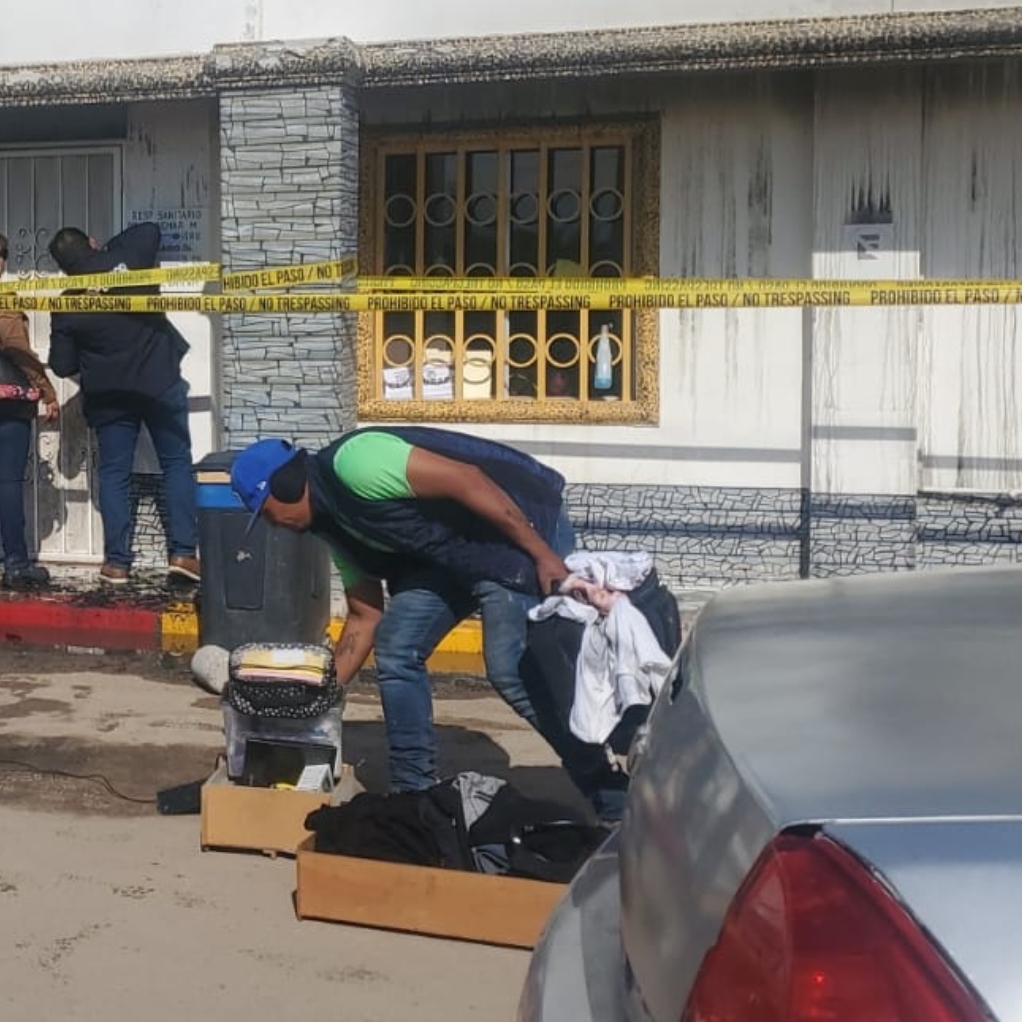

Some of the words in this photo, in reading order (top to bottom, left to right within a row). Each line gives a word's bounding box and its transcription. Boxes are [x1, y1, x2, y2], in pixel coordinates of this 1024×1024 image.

[261, 272, 274, 286] EL
[276, 268, 304, 284] PASO
[317, 265, 332, 280] NO
[0, 298, 11, 310] EL
[14, 298, 37, 310] PASO
[48, 298, 62, 311] NO
[65, 298, 131, 311] TRESPASSING
[147, 298, 201, 311] PROHIBIDO
[204, 298, 216, 311] EL
[219, 298, 246, 311] PASO
[259, 298, 273, 310] NO
[276, 297, 350, 310] TRESPASSING
[367, 296, 426, 310] PROHIBIDO
[431, 296, 444, 309] EL
[448, 296, 475, 309] PASO
[491, 296, 507, 309] NO
[511, 294, 590, 309] TRESPASSING
[609, 294, 674, 308] PROHIBIDO
[679, 294, 692, 308] EL
[696, 294, 726, 308] PASO
[743, 292, 759, 307] NO
[764, 291, 851, 307] TRESPASSING
[871, 289, 941, 305] PROHIBIDO
[945, 289, 961, 304] EL
[965, 288, 999, 304] PASO
